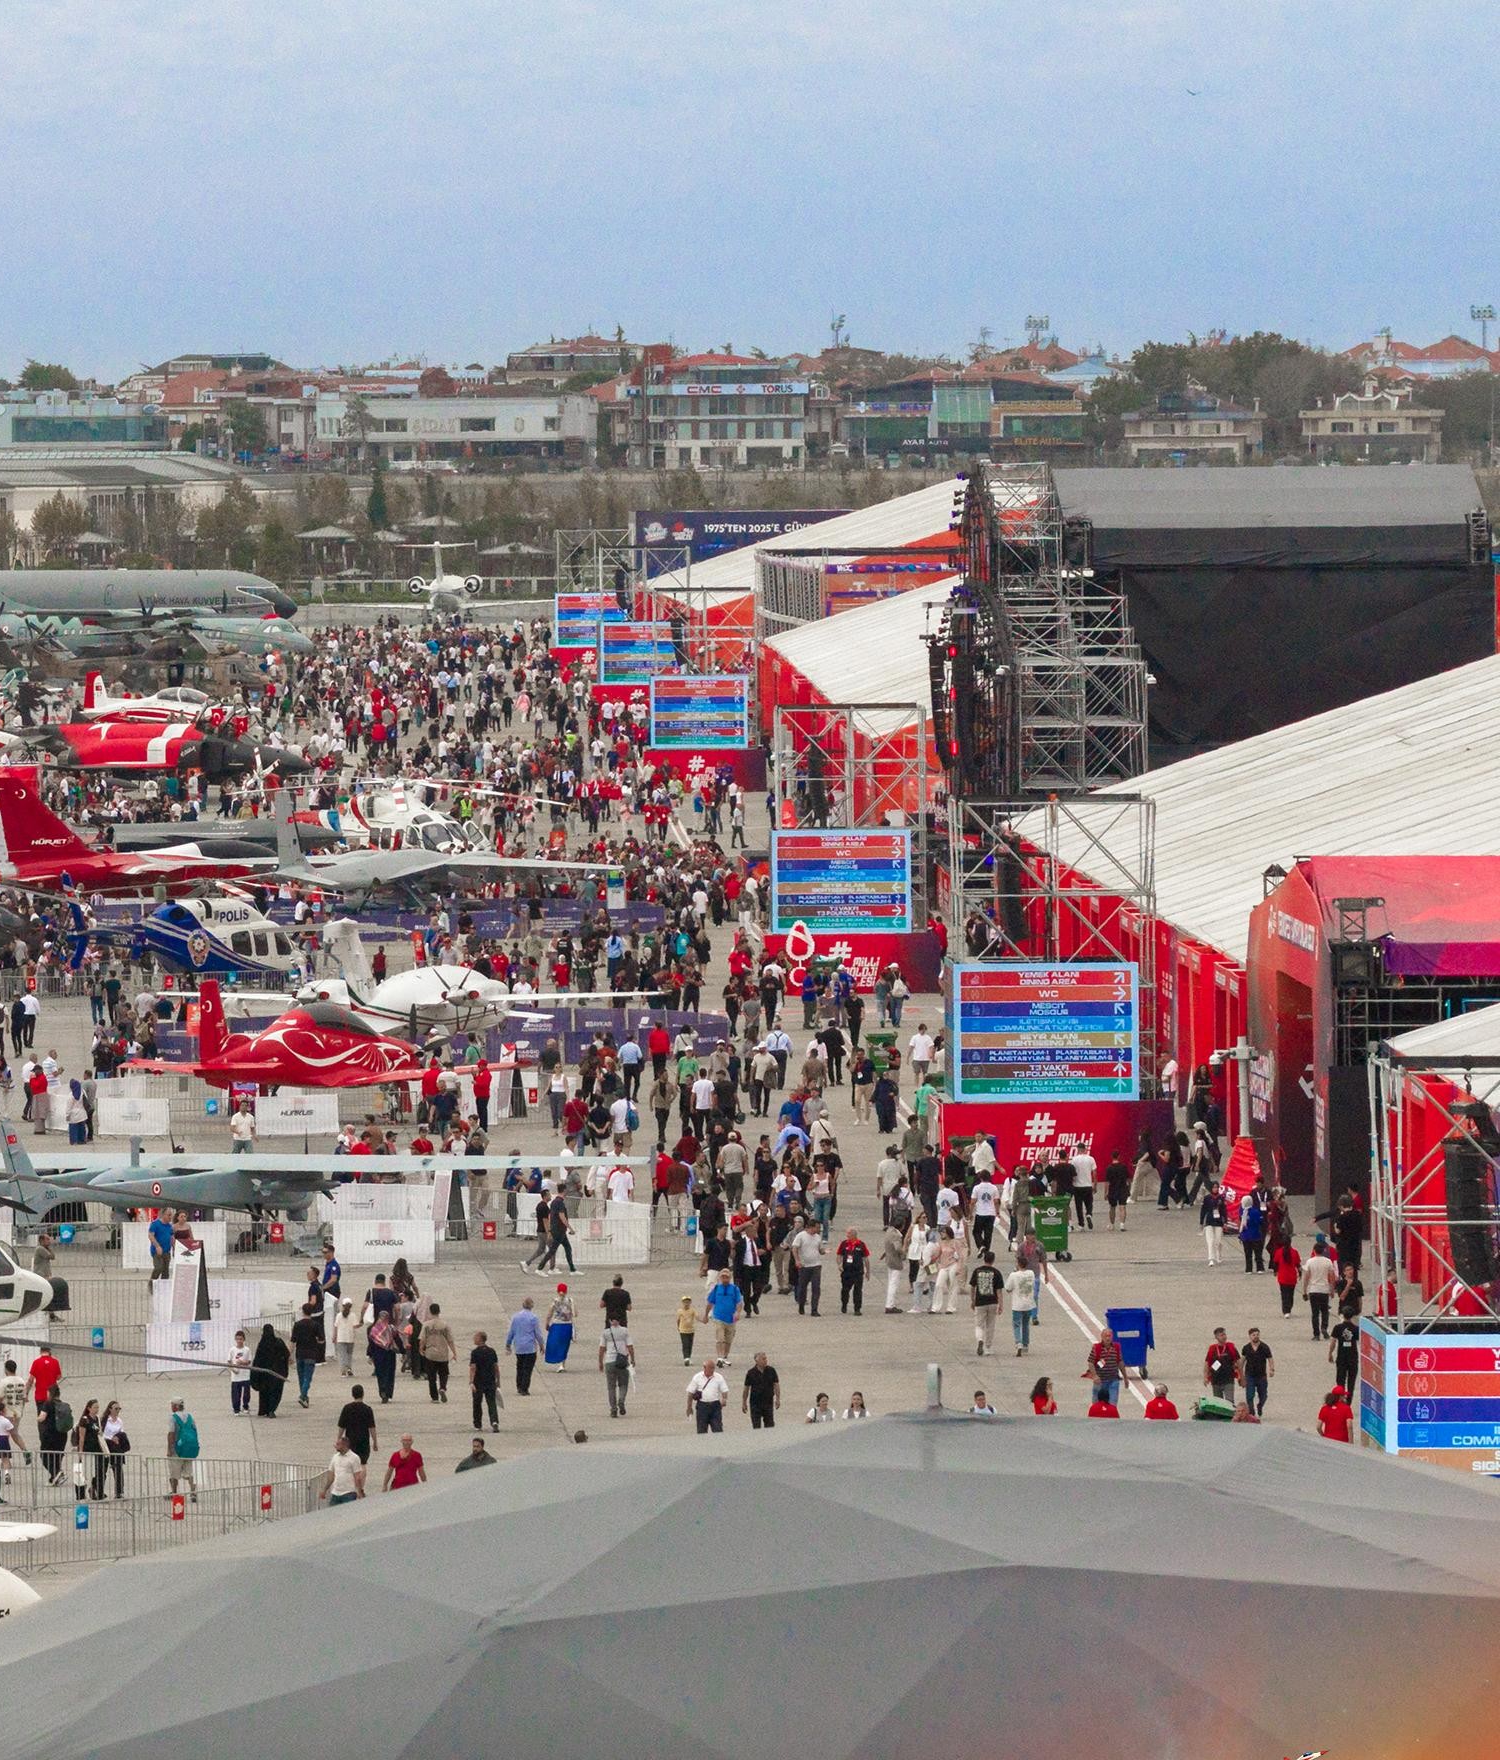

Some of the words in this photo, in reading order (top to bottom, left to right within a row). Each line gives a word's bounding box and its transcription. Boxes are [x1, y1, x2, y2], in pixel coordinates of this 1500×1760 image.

[761, 384, 793, 394] TORUS
[704, 523, 747, 533] 1975'TEN
[31, 837, 68, 846] HÜRJET
[219, 906, 250, 922] POLİS
[1038, 990, 1059, 998] WC
[1023, 1112, 1057, 1143] #
[181, 1340, 206, 1351] T925
